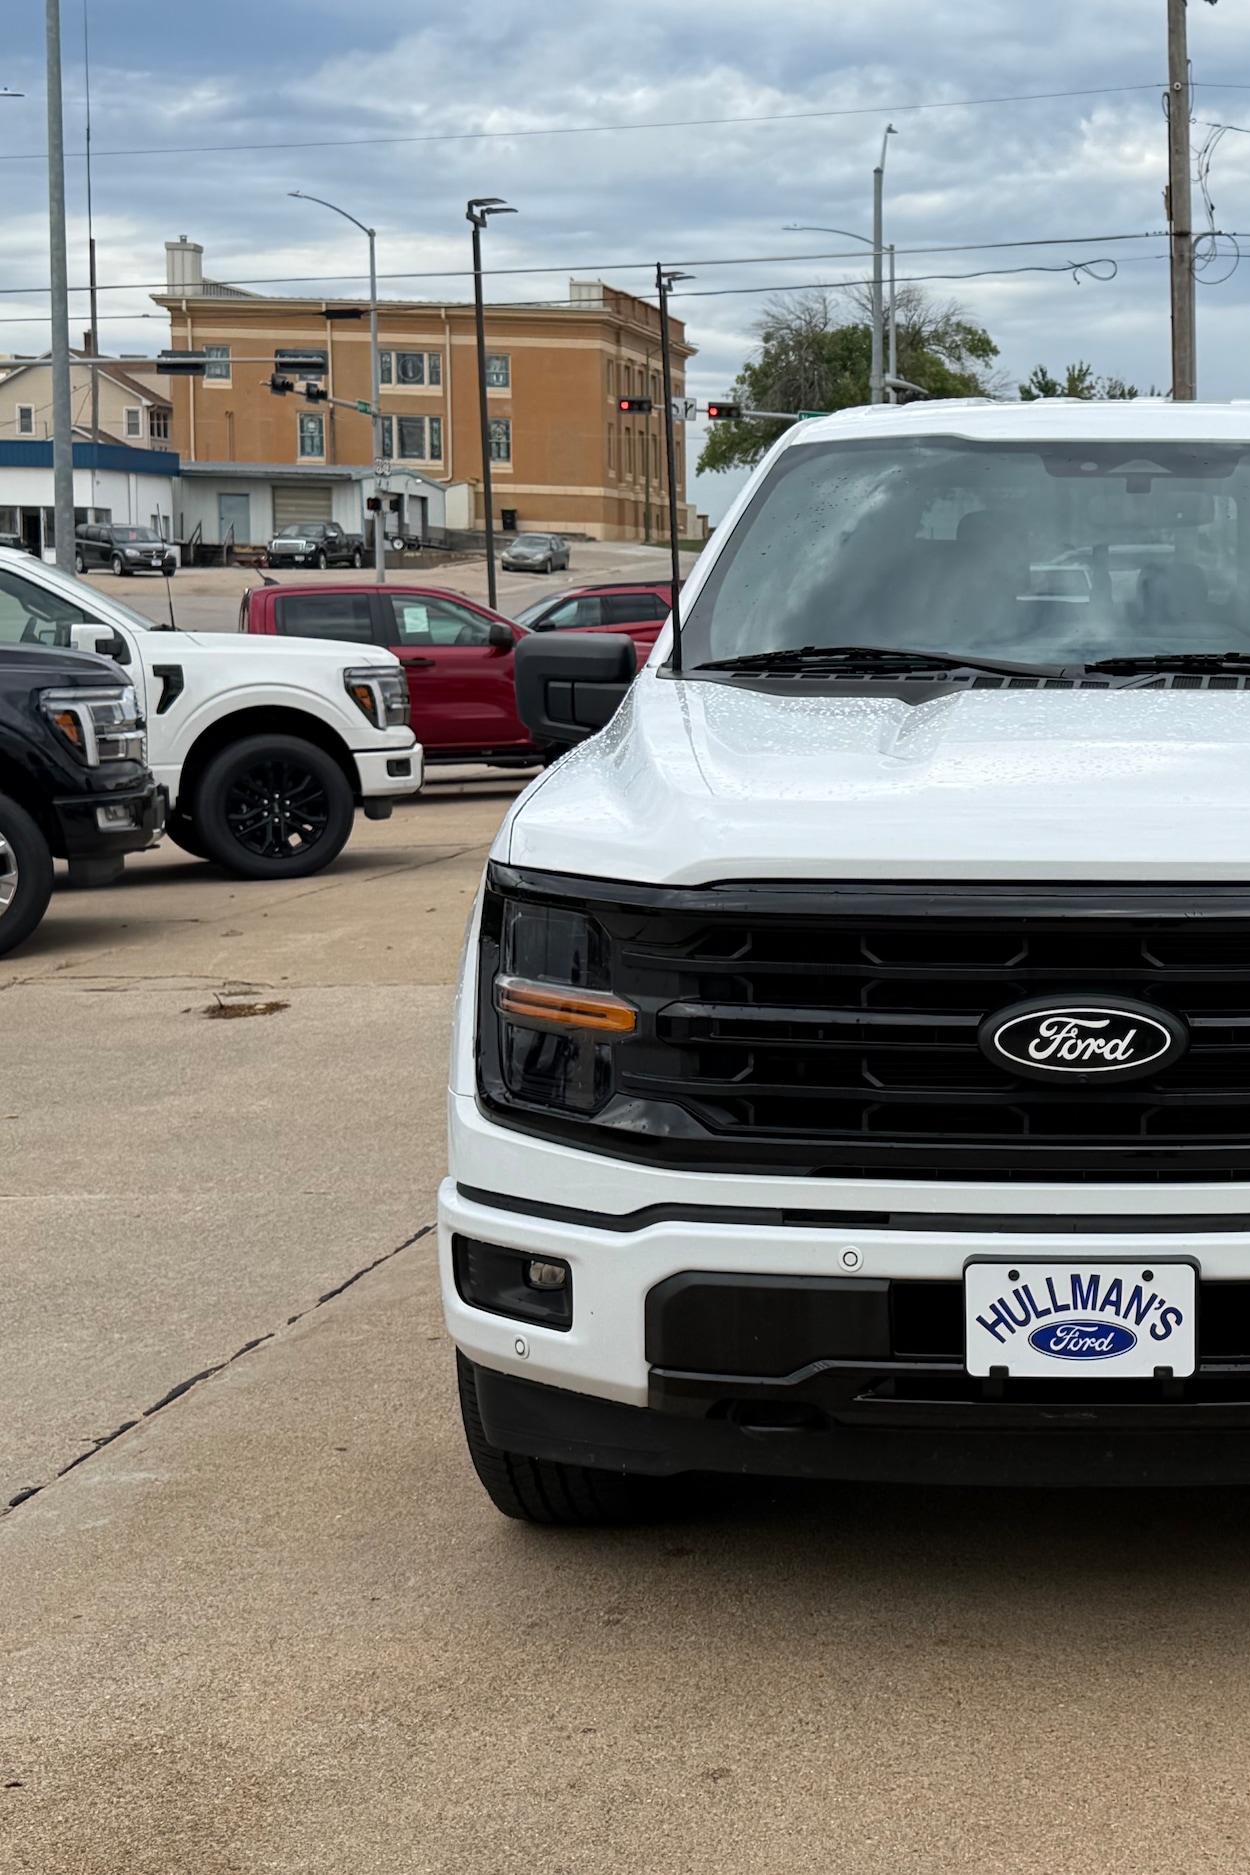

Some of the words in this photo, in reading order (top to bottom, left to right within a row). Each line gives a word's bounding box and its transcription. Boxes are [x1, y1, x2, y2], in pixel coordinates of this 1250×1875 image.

[1028, 1016, 1138, 1061] Ford
[975, 1273, 1184, 1344] HULLMAN'S
[1049, 1324, 1115, 1352] Ford
